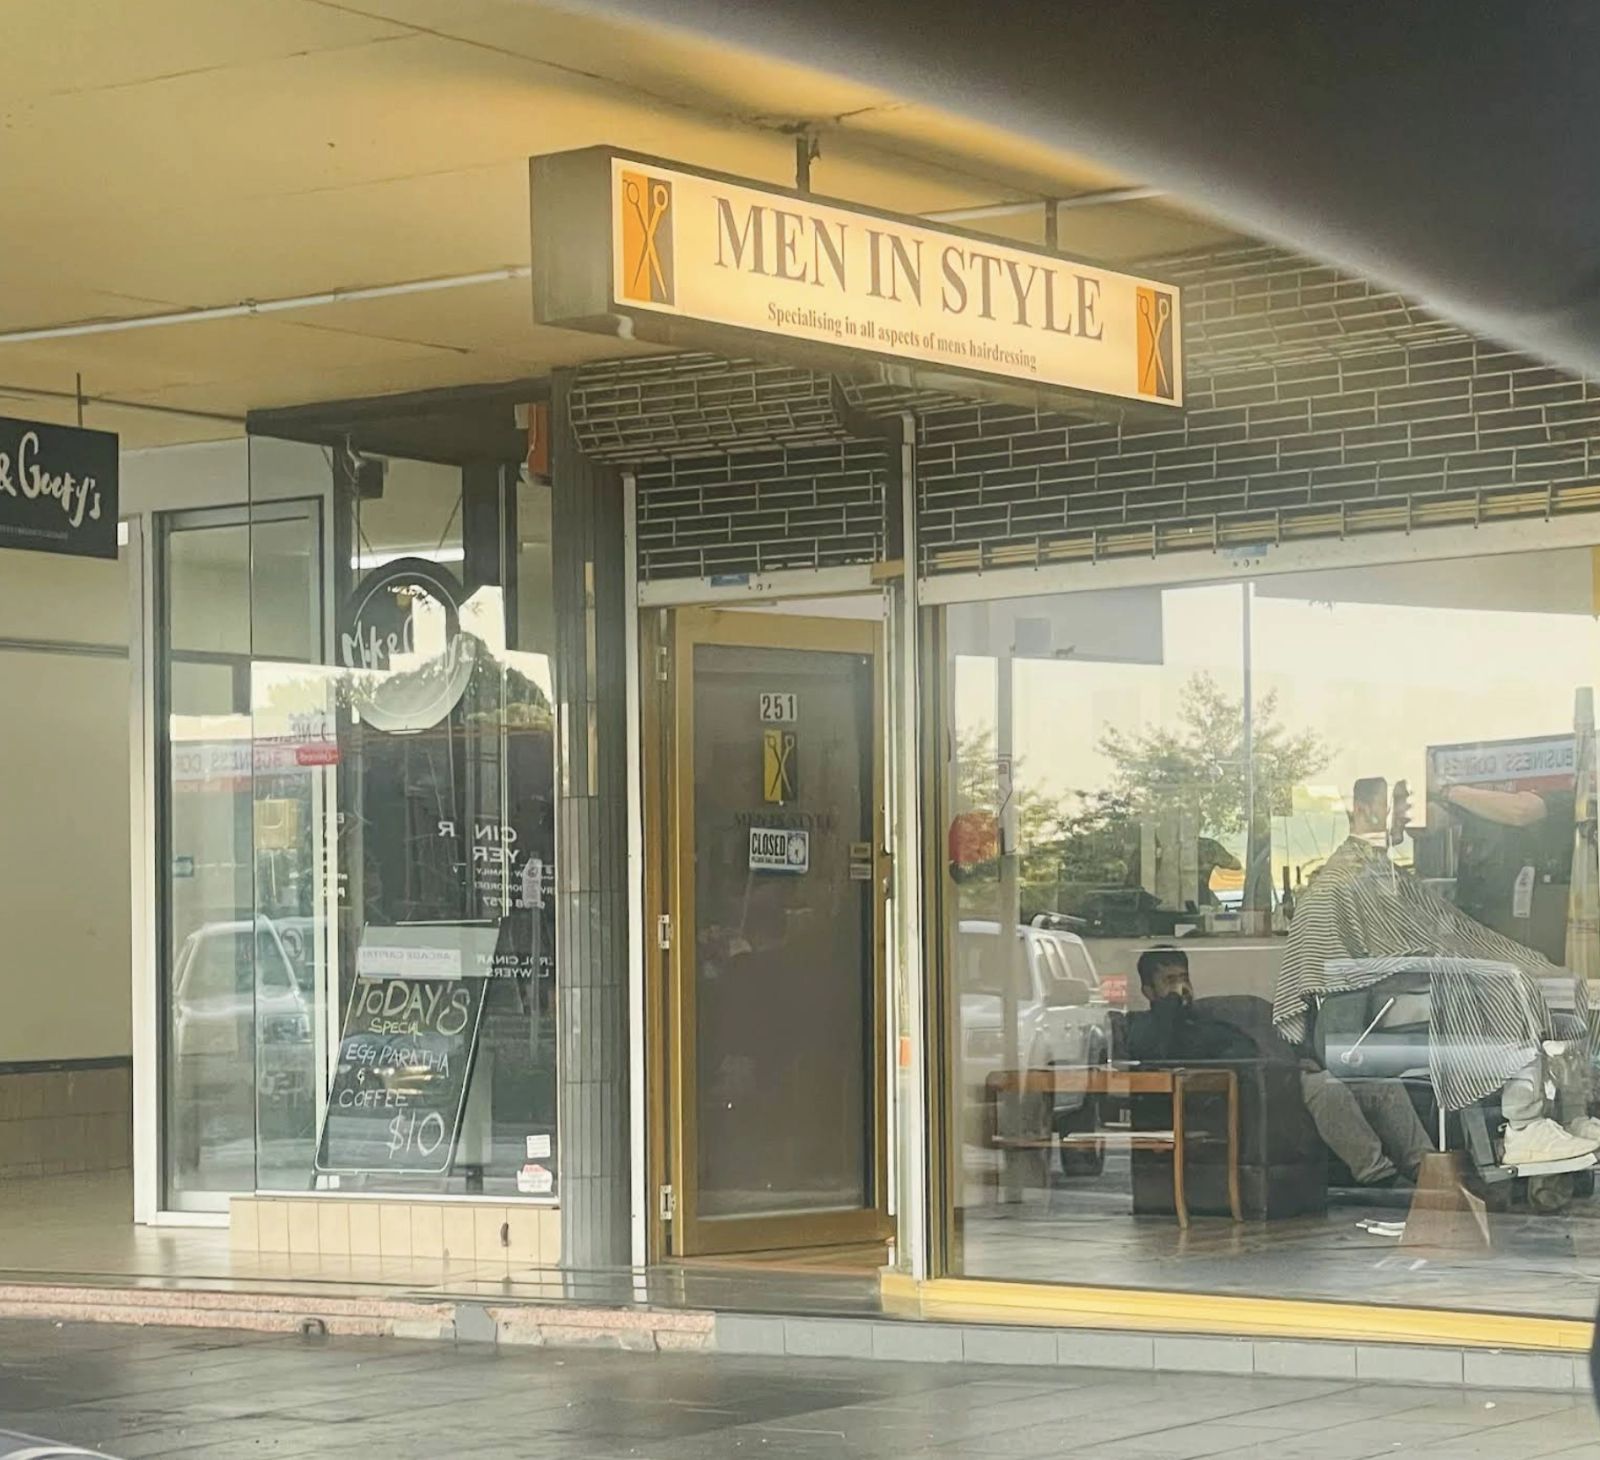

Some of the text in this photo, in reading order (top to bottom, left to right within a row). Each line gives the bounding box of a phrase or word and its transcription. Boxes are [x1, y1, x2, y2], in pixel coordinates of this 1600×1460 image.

[713, 196, 1103, 342] MEN IN STYLE
[768, 301, 1037, 372] Specialising in all aspects of mens hairdressing
[762, 695, 794, 720] 251
[752, 832, 785, 856] CLOSED
[378, 1045, 449, 1078] PARATHA
[385, 1108, 445, 1160] $10
